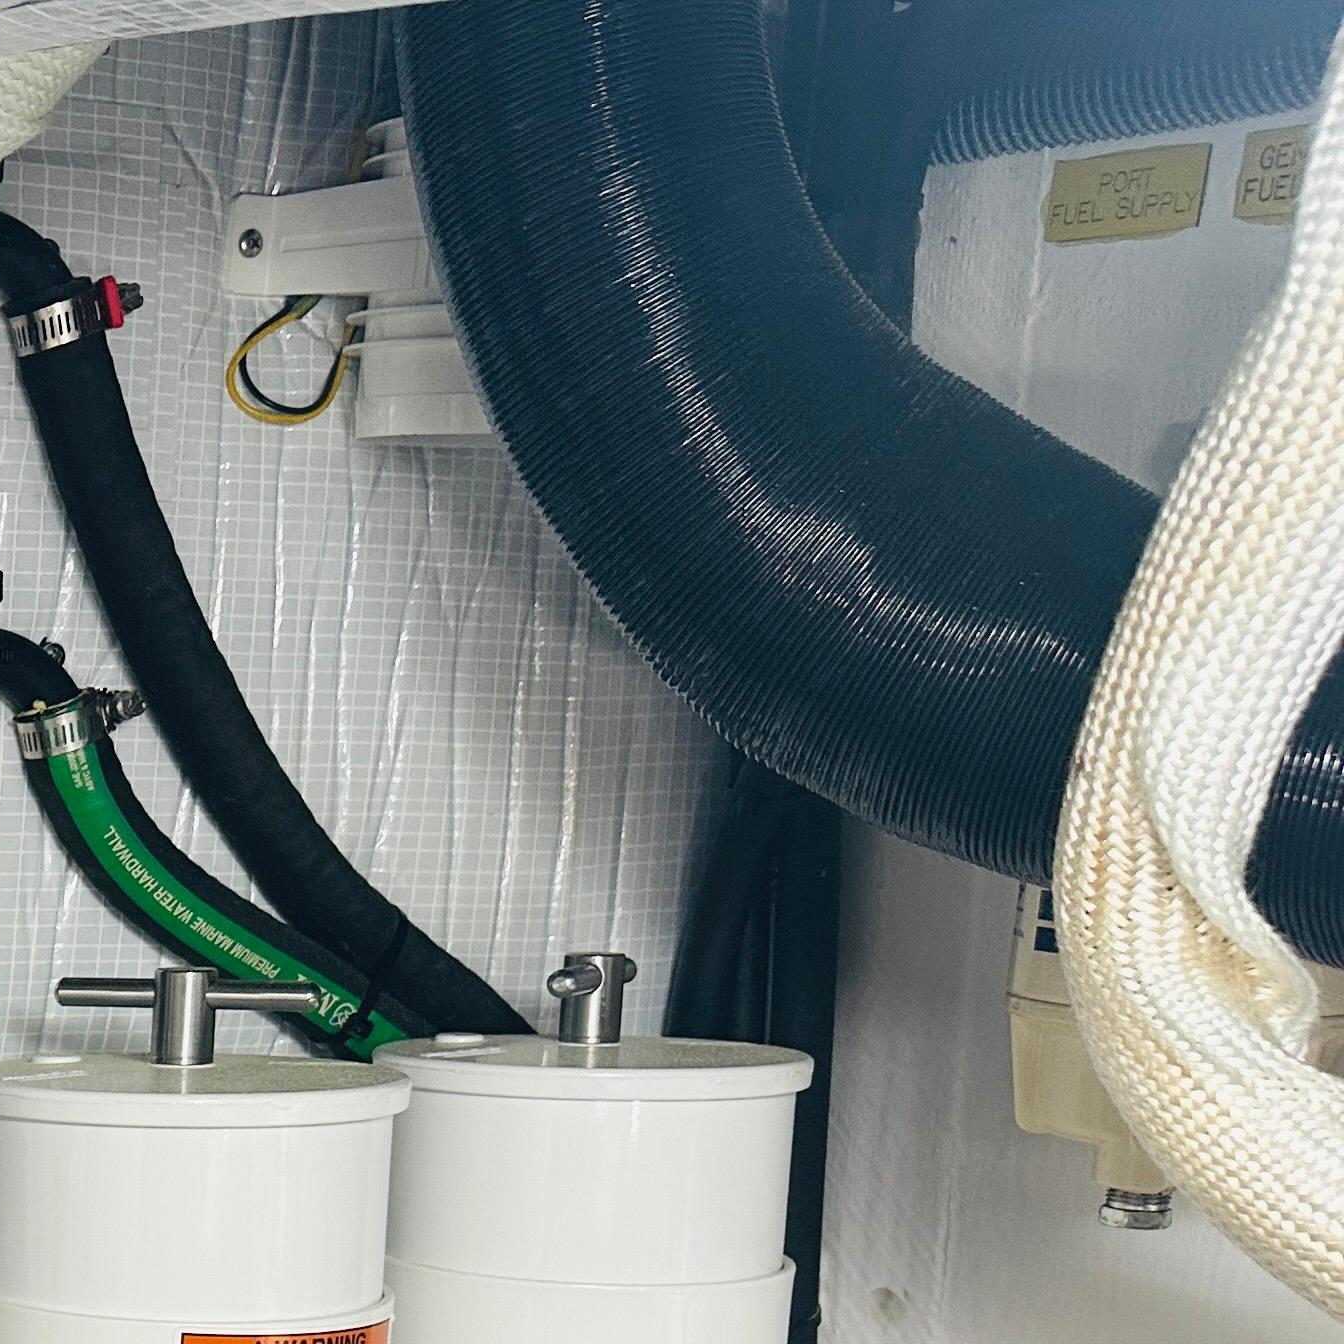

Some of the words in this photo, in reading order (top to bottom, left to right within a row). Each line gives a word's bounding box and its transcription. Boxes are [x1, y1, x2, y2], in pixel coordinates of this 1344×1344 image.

[1098, 167, 1157, 194] PORT
[1050, 201, 1104, 226] FUEL
[1114, 190, 1203, 220] SUPPLY
[105, 825, 162, 895] HARDWALL
[152, 886, 195, 925] WATER
[189, 917, 235, 951] MARINE
[229, 943, 282, 979] PREMIUM
